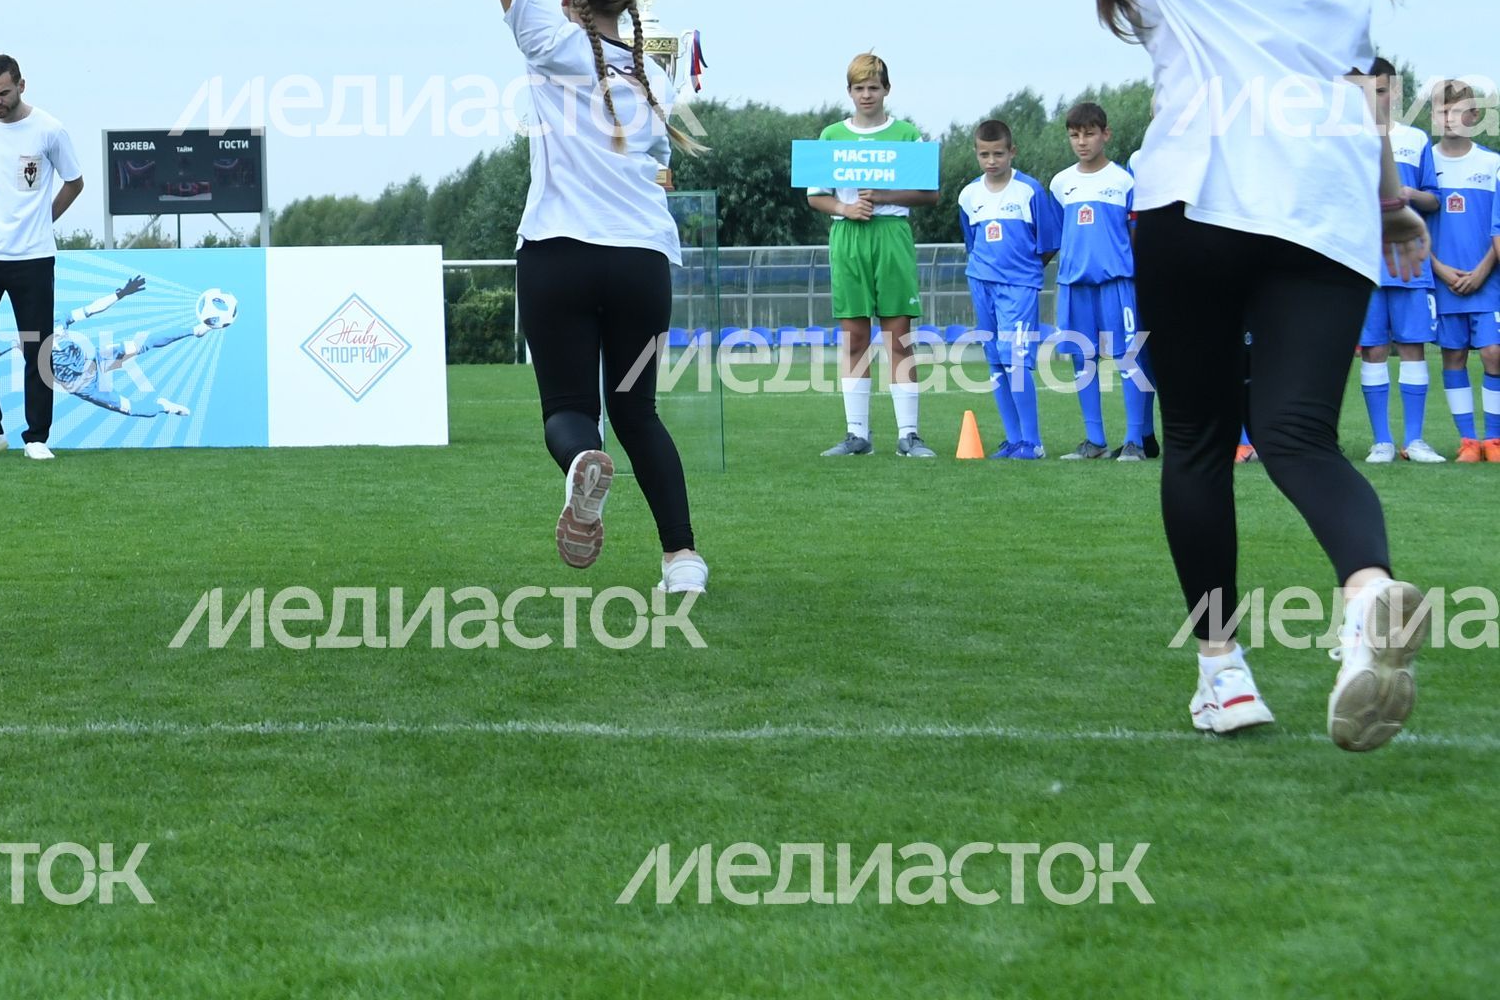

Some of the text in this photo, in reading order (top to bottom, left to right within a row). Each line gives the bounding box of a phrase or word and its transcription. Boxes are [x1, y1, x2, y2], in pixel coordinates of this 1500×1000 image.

[112, 141, 156, 151] ХОЗЯЕВА
[218, 140, 249, 150] ГОСТИ
[833, 149, 897, 163] МАСТЕР
[833, 168, 896, 182] САТУРН
